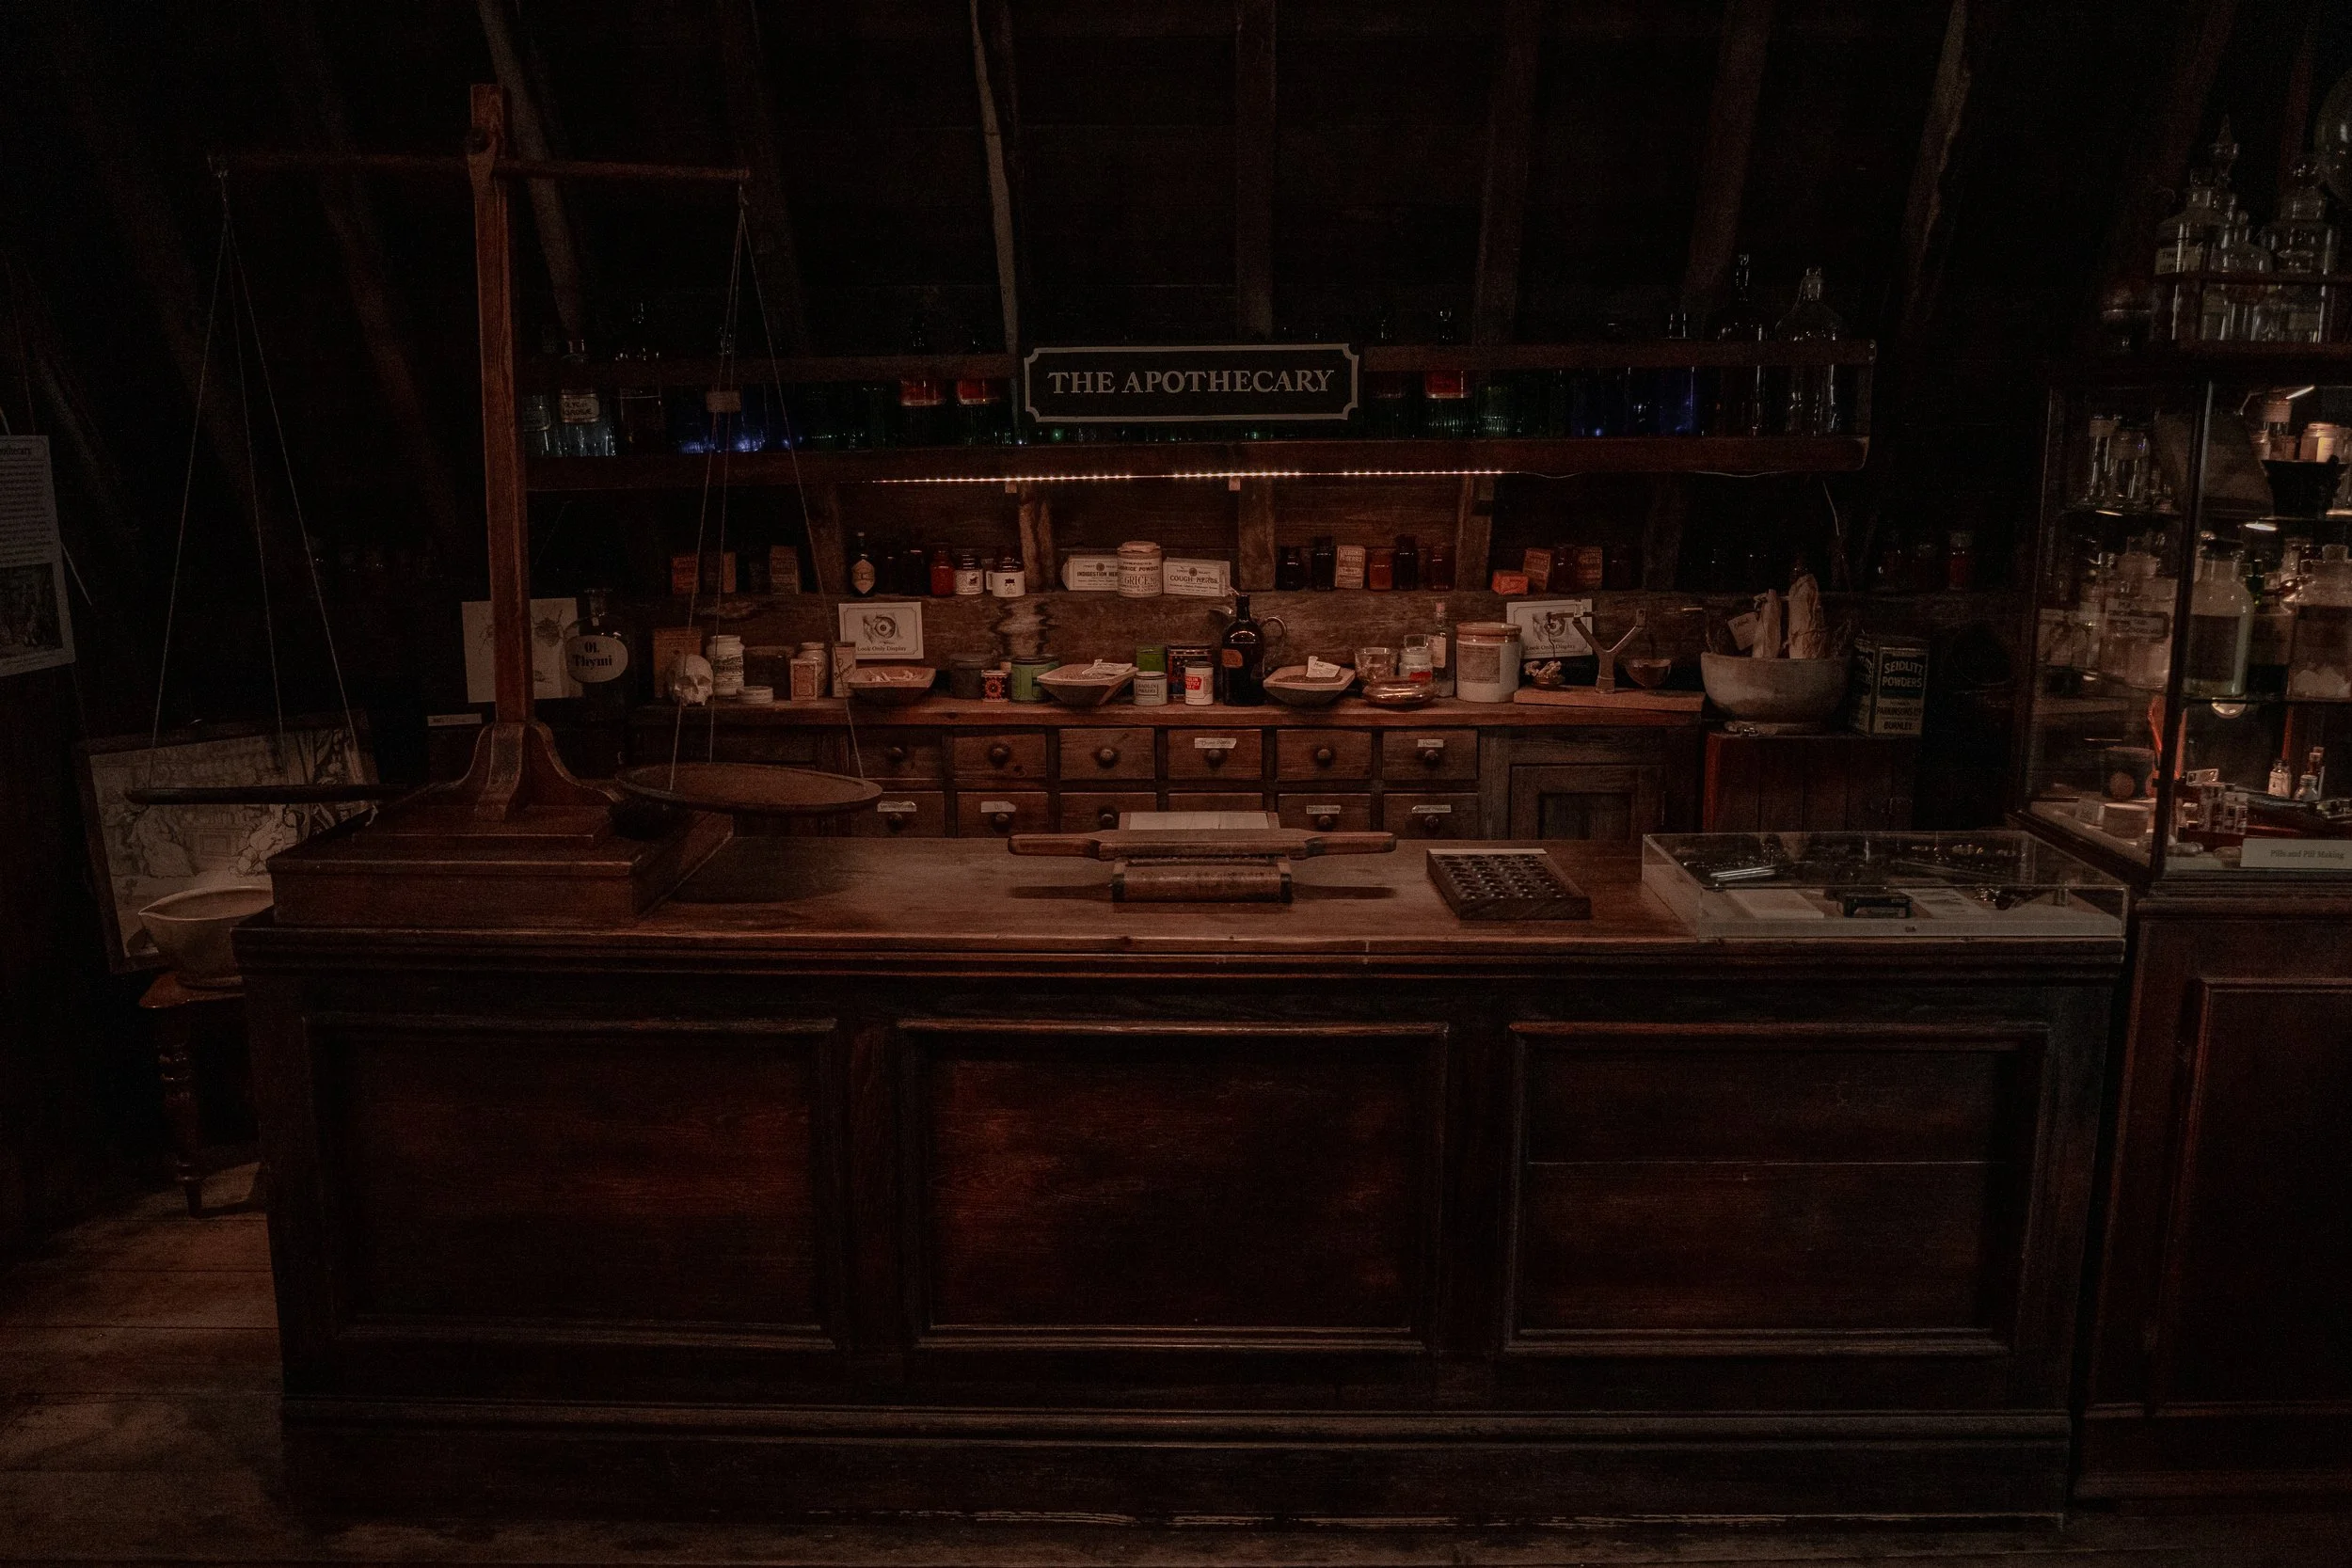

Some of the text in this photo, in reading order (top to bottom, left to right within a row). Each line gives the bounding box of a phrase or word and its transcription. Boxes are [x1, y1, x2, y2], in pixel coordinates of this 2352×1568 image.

[1047, 370, 1334, 394] THE APOTHECARY
[572, 654, 612, 670] Thymi
[1884, 659, 1924, 675] SEIDLITZ
[1883, 676, 1922, 688] POWDERS
[1883, 721, 1913, 730] BURNLEY
[2270, 849, 2286, 858] Pills
[2286, 849, 2302, 858] and
[2317, 850, 2344, 860] Making
